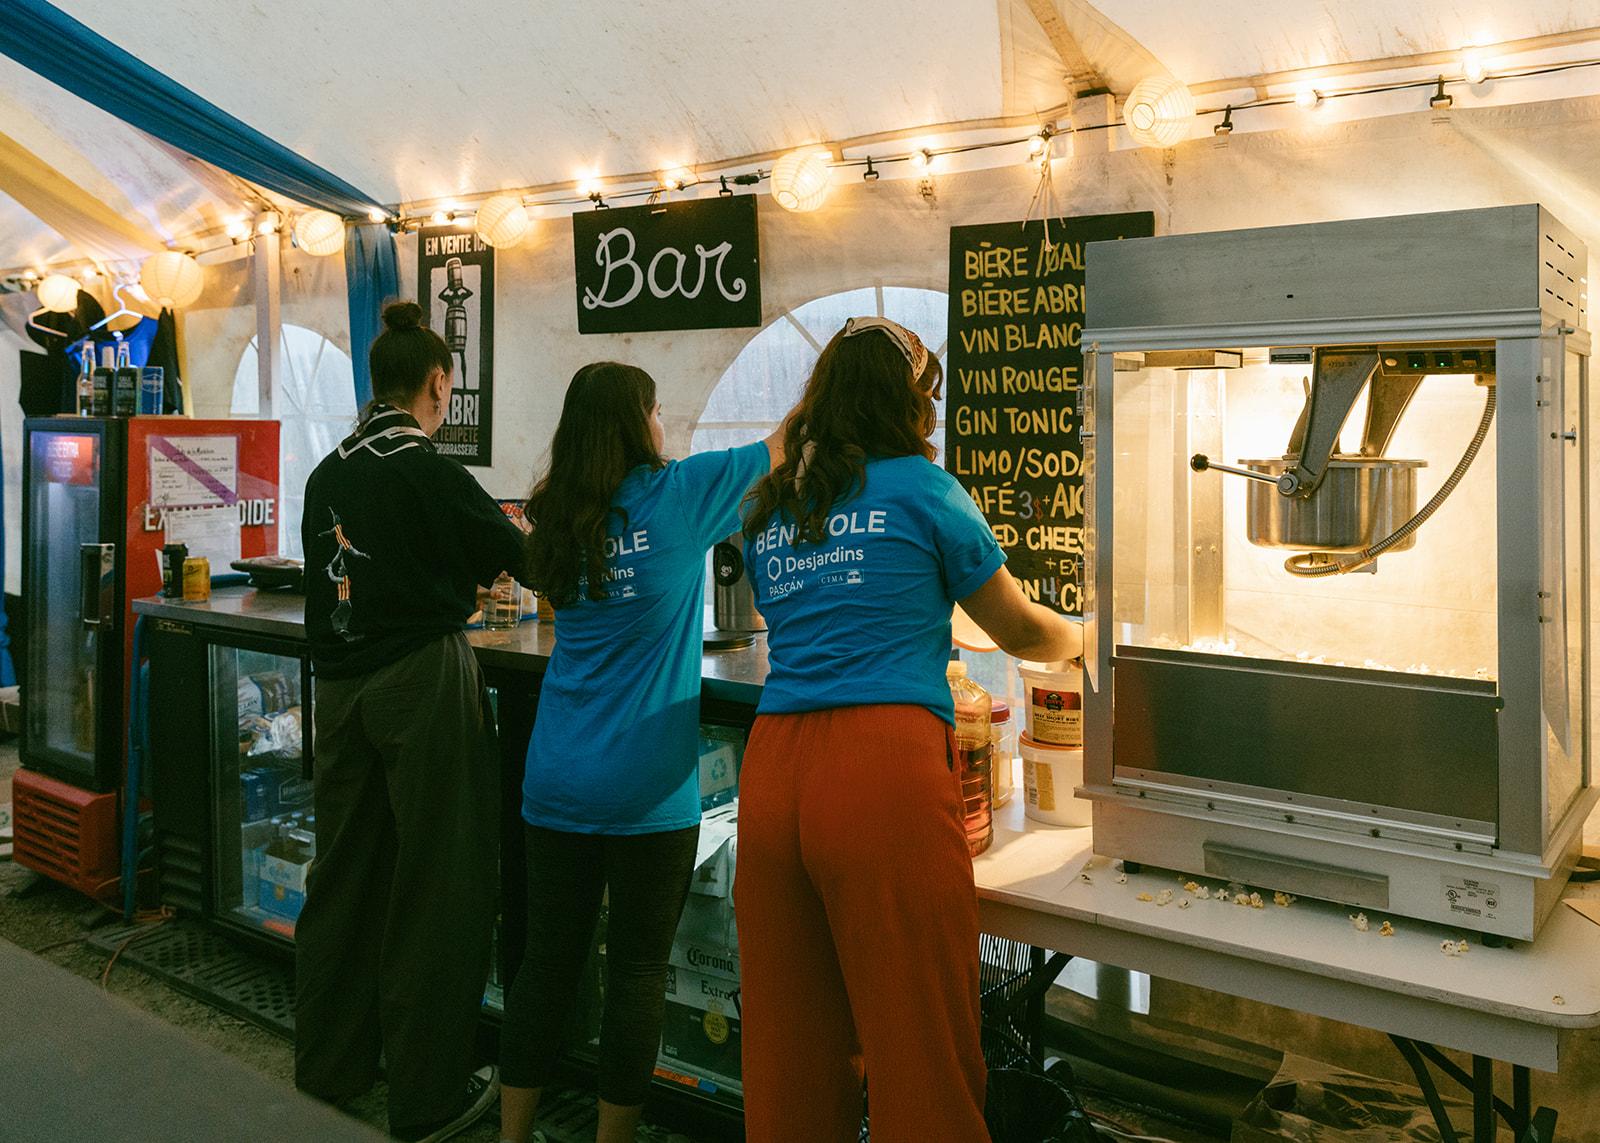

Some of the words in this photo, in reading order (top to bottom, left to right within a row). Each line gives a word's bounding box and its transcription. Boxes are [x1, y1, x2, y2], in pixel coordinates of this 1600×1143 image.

[425, 236, 439, 256] EN
[440, 234, 472, 255] VENTE
[582, 227, 747, 310] Bar
[1033, 283, 1086, 316] ABRI
[959, 326, 1000, 354] VIN
[1004, 322, 1081, 353] BLANC
[958, 367, 997, 396] VIN
[1001, 366, 1079, 396] ROUGE
[955, 405, 998, 436] GIN
[1003, 406, 1074, 435] TONIC
[956, 446, 1085, 482] LIMO/SOD
[755, 510, 887, 556] BÉNOLE
[785, 545, 865, 573] Desjardins
[686, 946, 737, 976] Corona
[700, 979, 733, 1000] Extra
